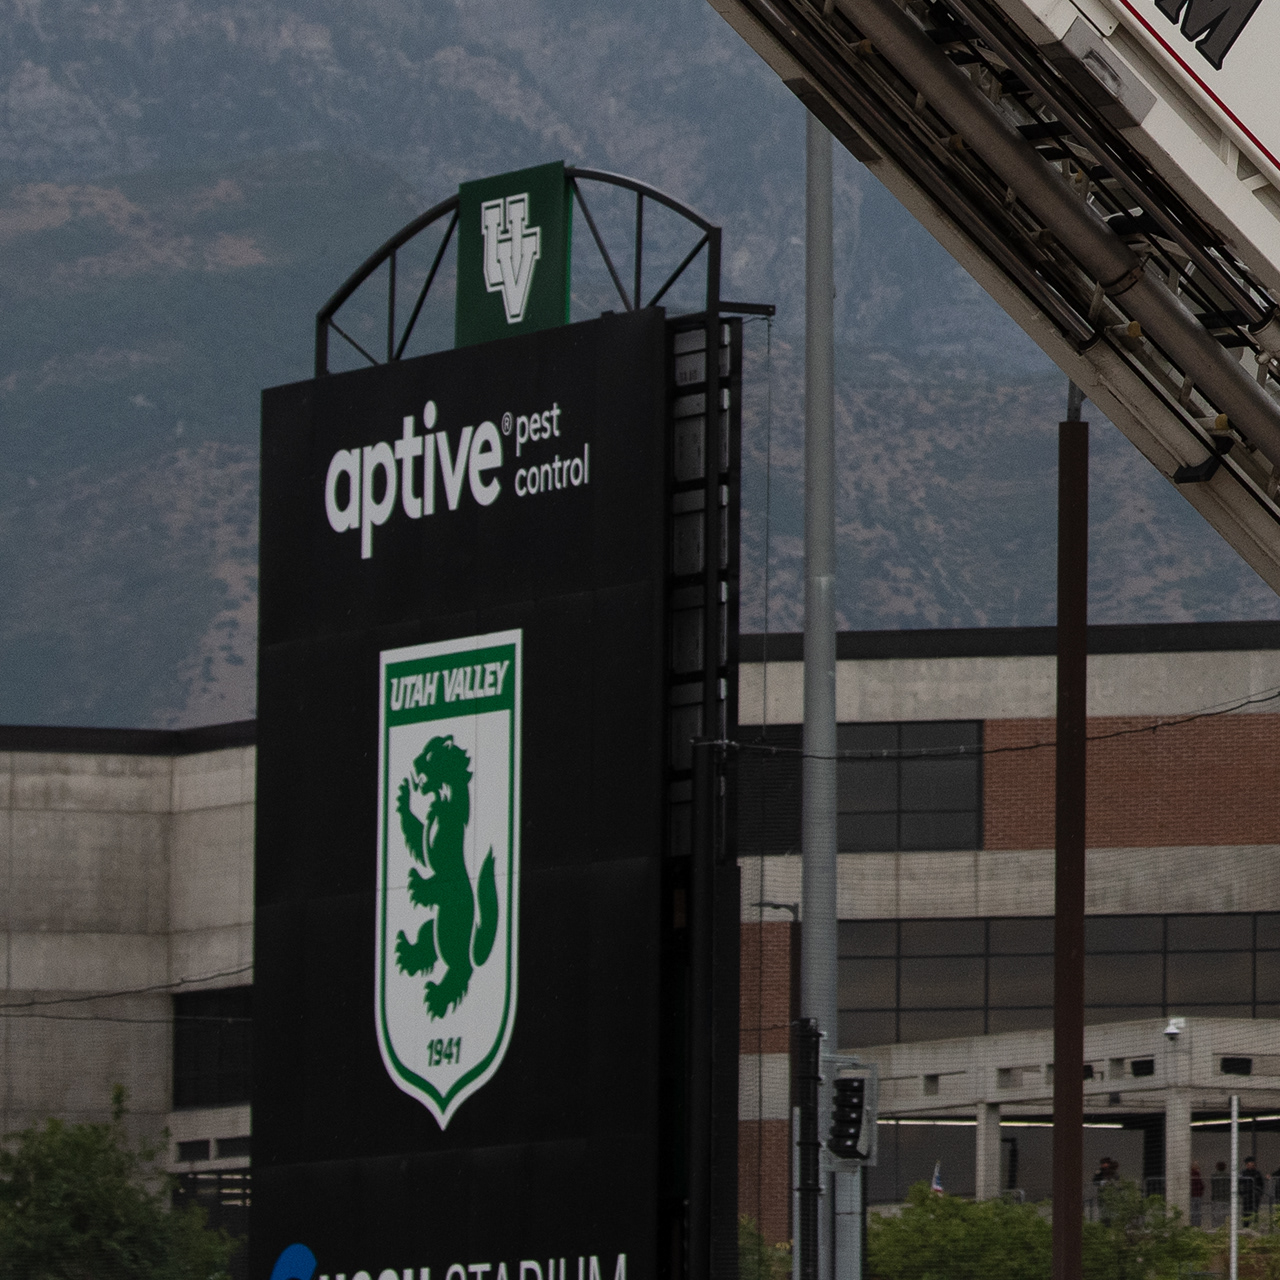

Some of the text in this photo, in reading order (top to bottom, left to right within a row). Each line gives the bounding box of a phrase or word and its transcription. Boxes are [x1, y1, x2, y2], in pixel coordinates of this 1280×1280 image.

[516, 402, 561, 457] pest
[515, 443, 590, 497] control
[389, 660, 510, 711] UTAH VALLEY
[427, 1036, 462, 1067] 1941
